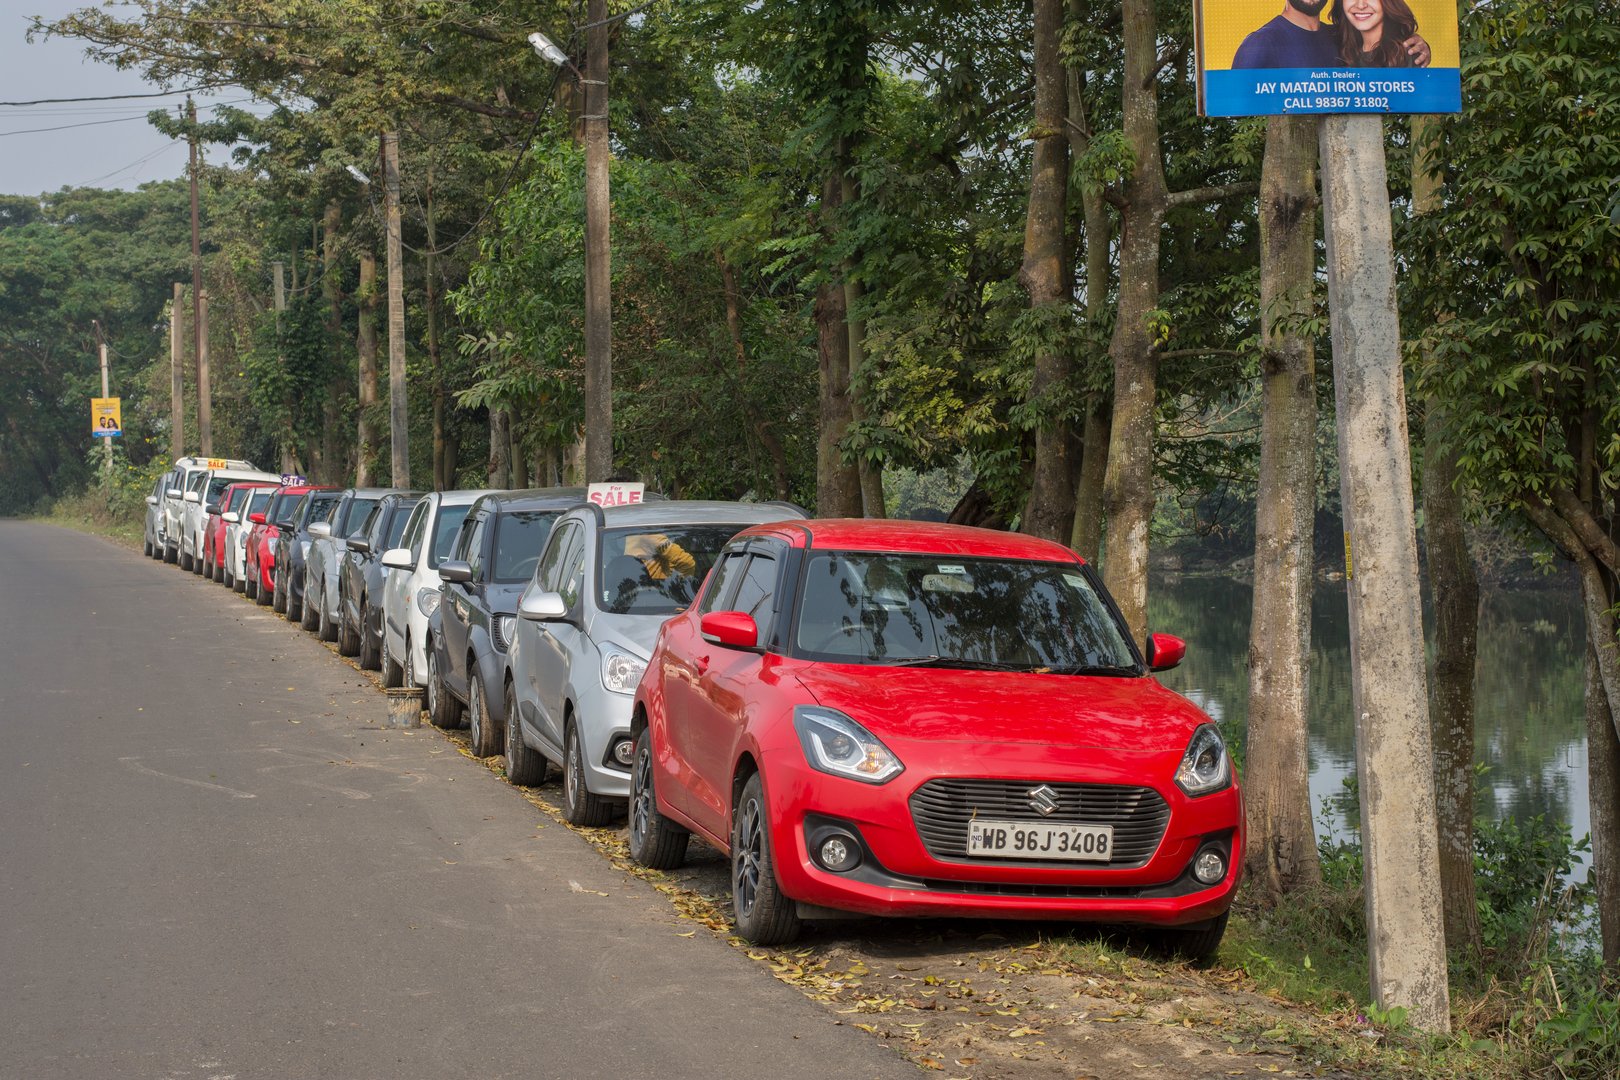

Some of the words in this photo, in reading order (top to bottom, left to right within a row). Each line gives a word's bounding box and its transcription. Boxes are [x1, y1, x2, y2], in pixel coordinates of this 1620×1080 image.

[1310, 71, 1331, 79] Auth.
[1255, 82, 1277, 94] JAY
[1280, 81, 1331, 94] MATADI
[1333, 81, 1366, 93] IRON
[1368, 81, 1416, 93] STORES
[1284, 97, 1313, 109] CALL
[1315, 97, 1351, 108] 98367
[1353, 97, 1389, 108] 31802
[281, 476, 305, 487] SALE
[590, 491, 641, 506] SALE
[982, 828, 1007, 850] WB
